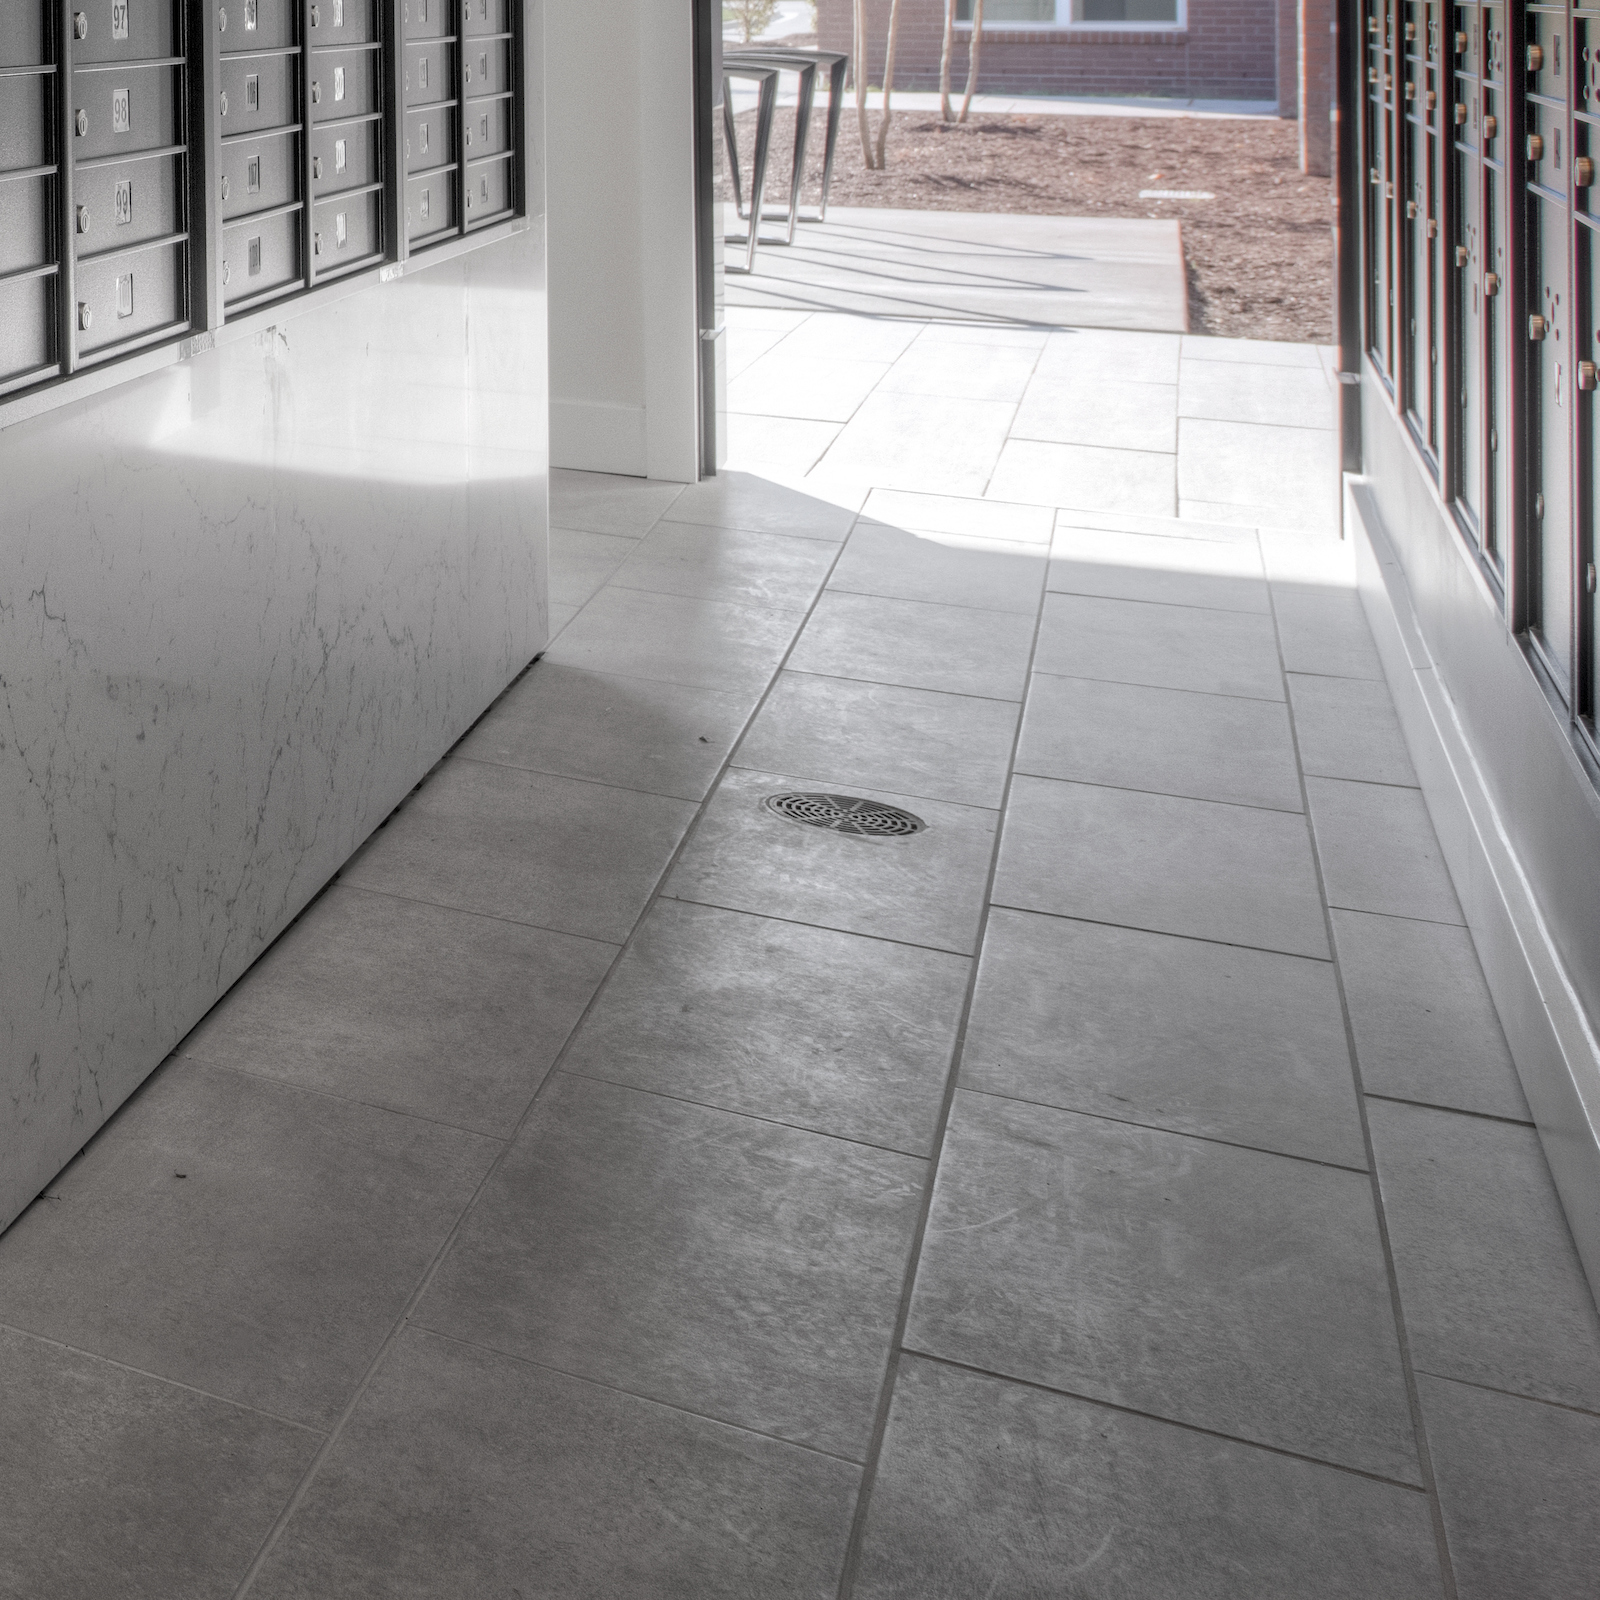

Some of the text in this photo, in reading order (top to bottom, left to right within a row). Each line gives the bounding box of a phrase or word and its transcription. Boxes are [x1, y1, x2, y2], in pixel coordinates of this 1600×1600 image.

[113, 4, 126, 31] 97
[113, 97, 128, 125] 98
[116, 188, 128, 216] 99
